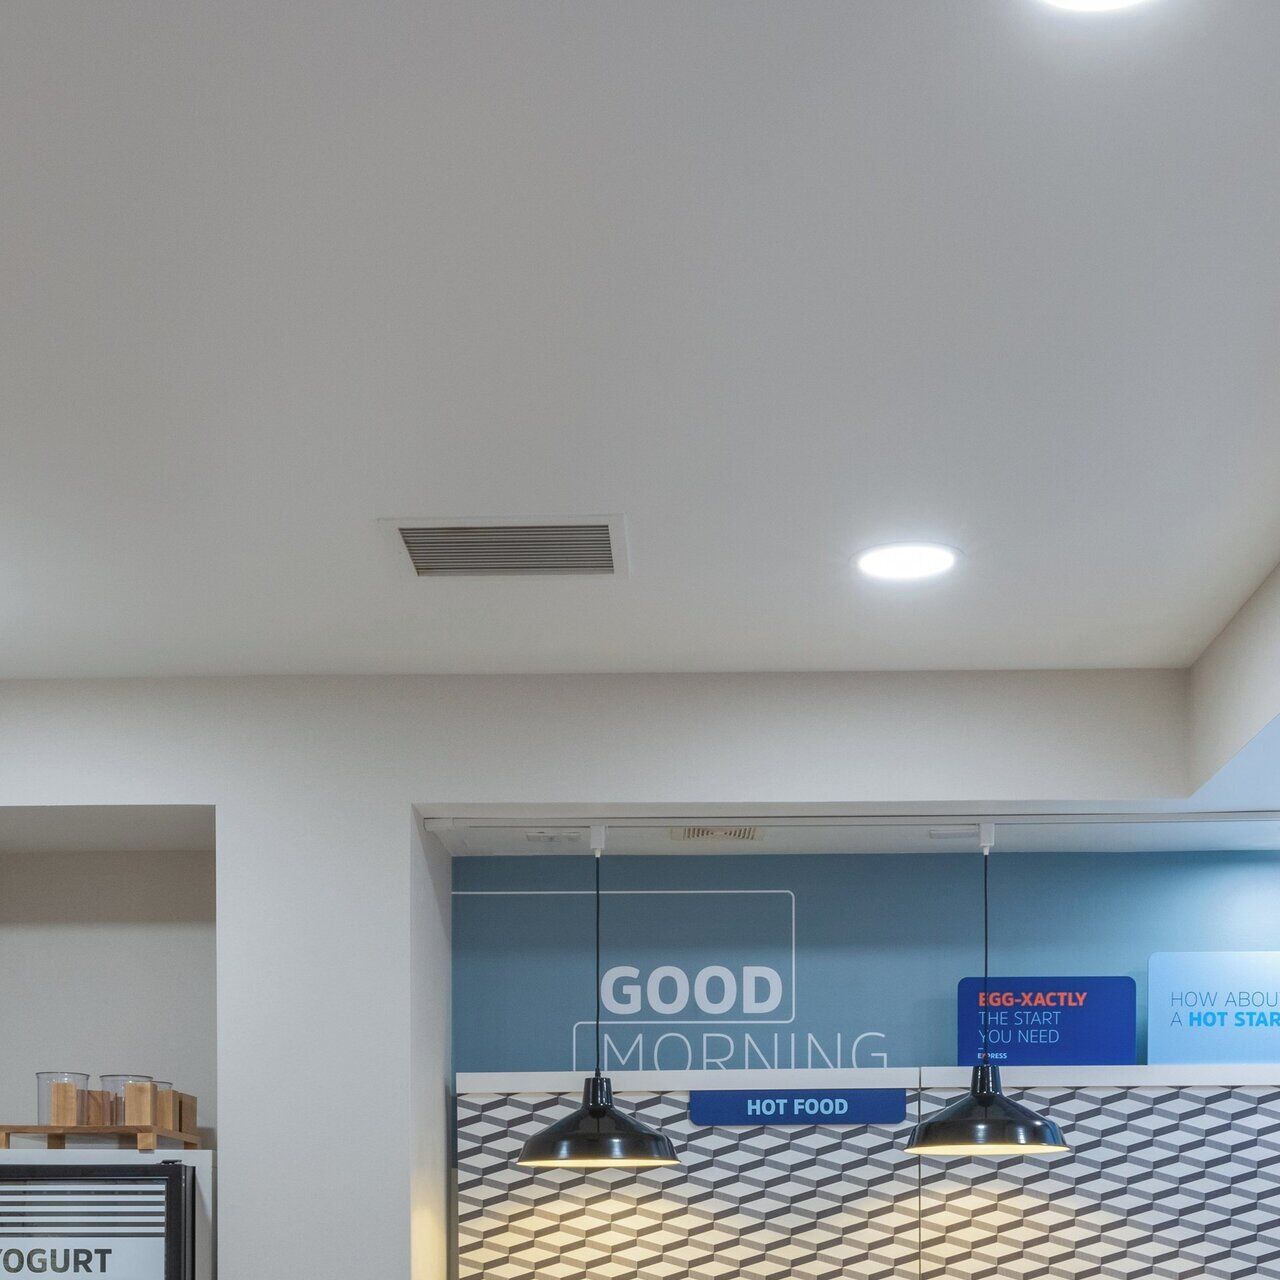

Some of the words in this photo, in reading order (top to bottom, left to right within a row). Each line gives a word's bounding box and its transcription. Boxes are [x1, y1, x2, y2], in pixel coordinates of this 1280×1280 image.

[600, 965, 783, 1015] GOOD
[978, 992, 1088, 1007] EGG-XACTLY
[1171, 991, 1218, 1007] HOW
[978, 1011, 1009, 1026] THE
[1014, 1011, 1062, 1026] START
[1170, 1011, 1183, 1027] A
[1188, 1011, 1228, 1027] HOT
[978, 1030, 1012, 1044] YOU
[1018, 1030, 1061, 1044] NEED
[602, 1032, 889, 1071] MORNING
[747, 1098, 787, 1116] HOT
[793, 1098, 848, 1116] FOOD
